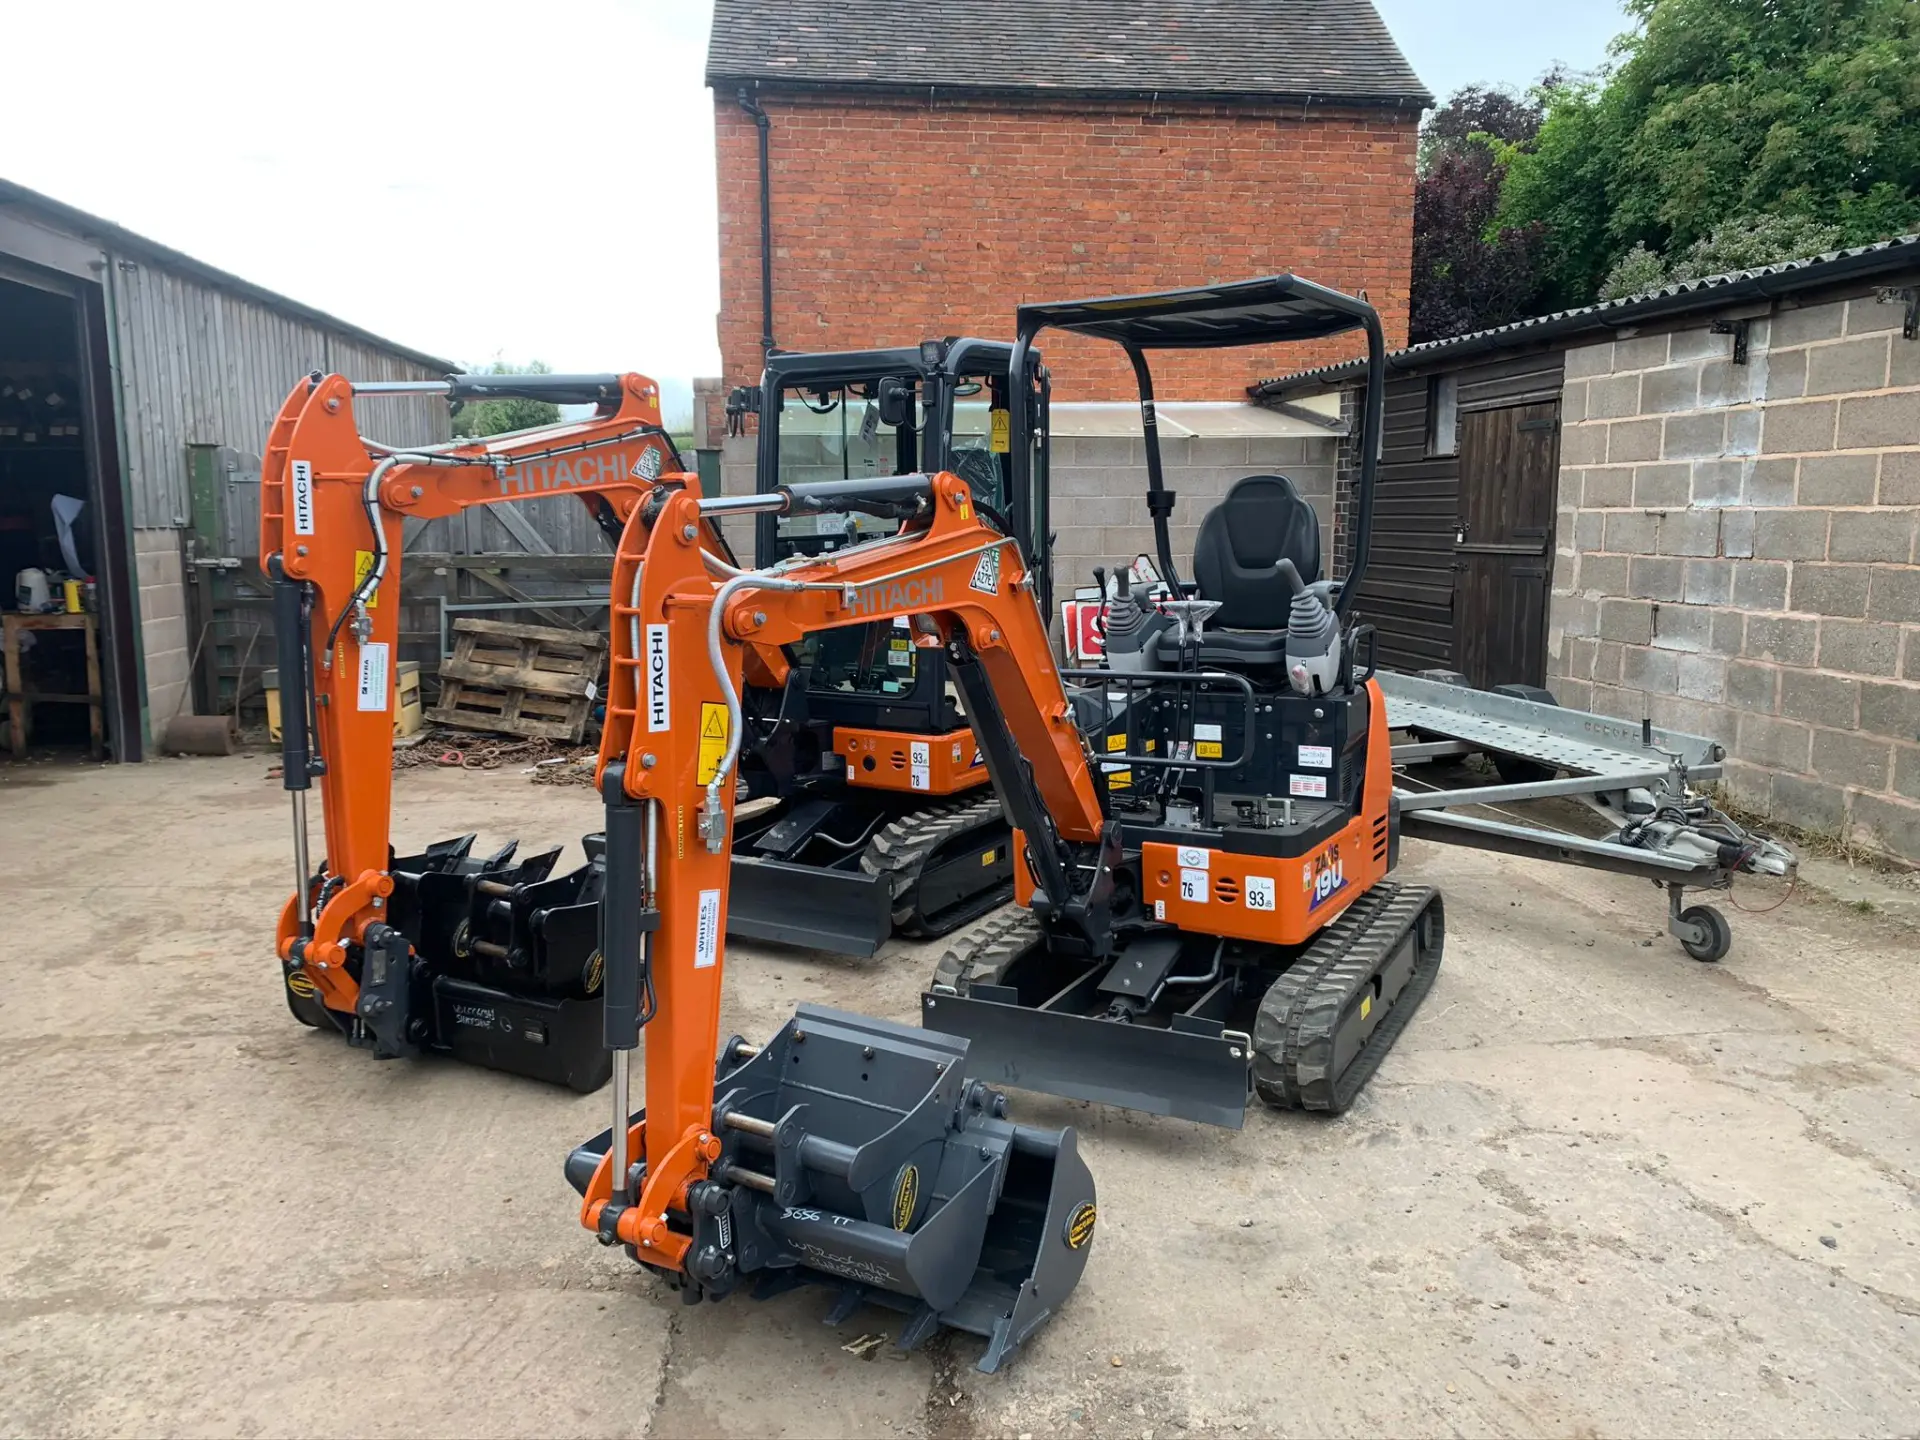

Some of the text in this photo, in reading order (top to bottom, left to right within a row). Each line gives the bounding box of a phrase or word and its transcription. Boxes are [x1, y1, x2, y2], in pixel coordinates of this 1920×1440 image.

[501, 453, 628, 494] HITACHI
[297, 465, 308, 530] HITACHI
[851, 577, 944, 616] HITACHI
[652, 631, 664, 725] HITACHI
[913, 752, 923, 764] 93
[912, 774, 920, 787] 78
[1182, 882, 1194, 898] 76
[1249, 891, 1265, 907] 93
[1315, 859, 1343, 901] 19U
[698, 905, 707, 952] WHITES
